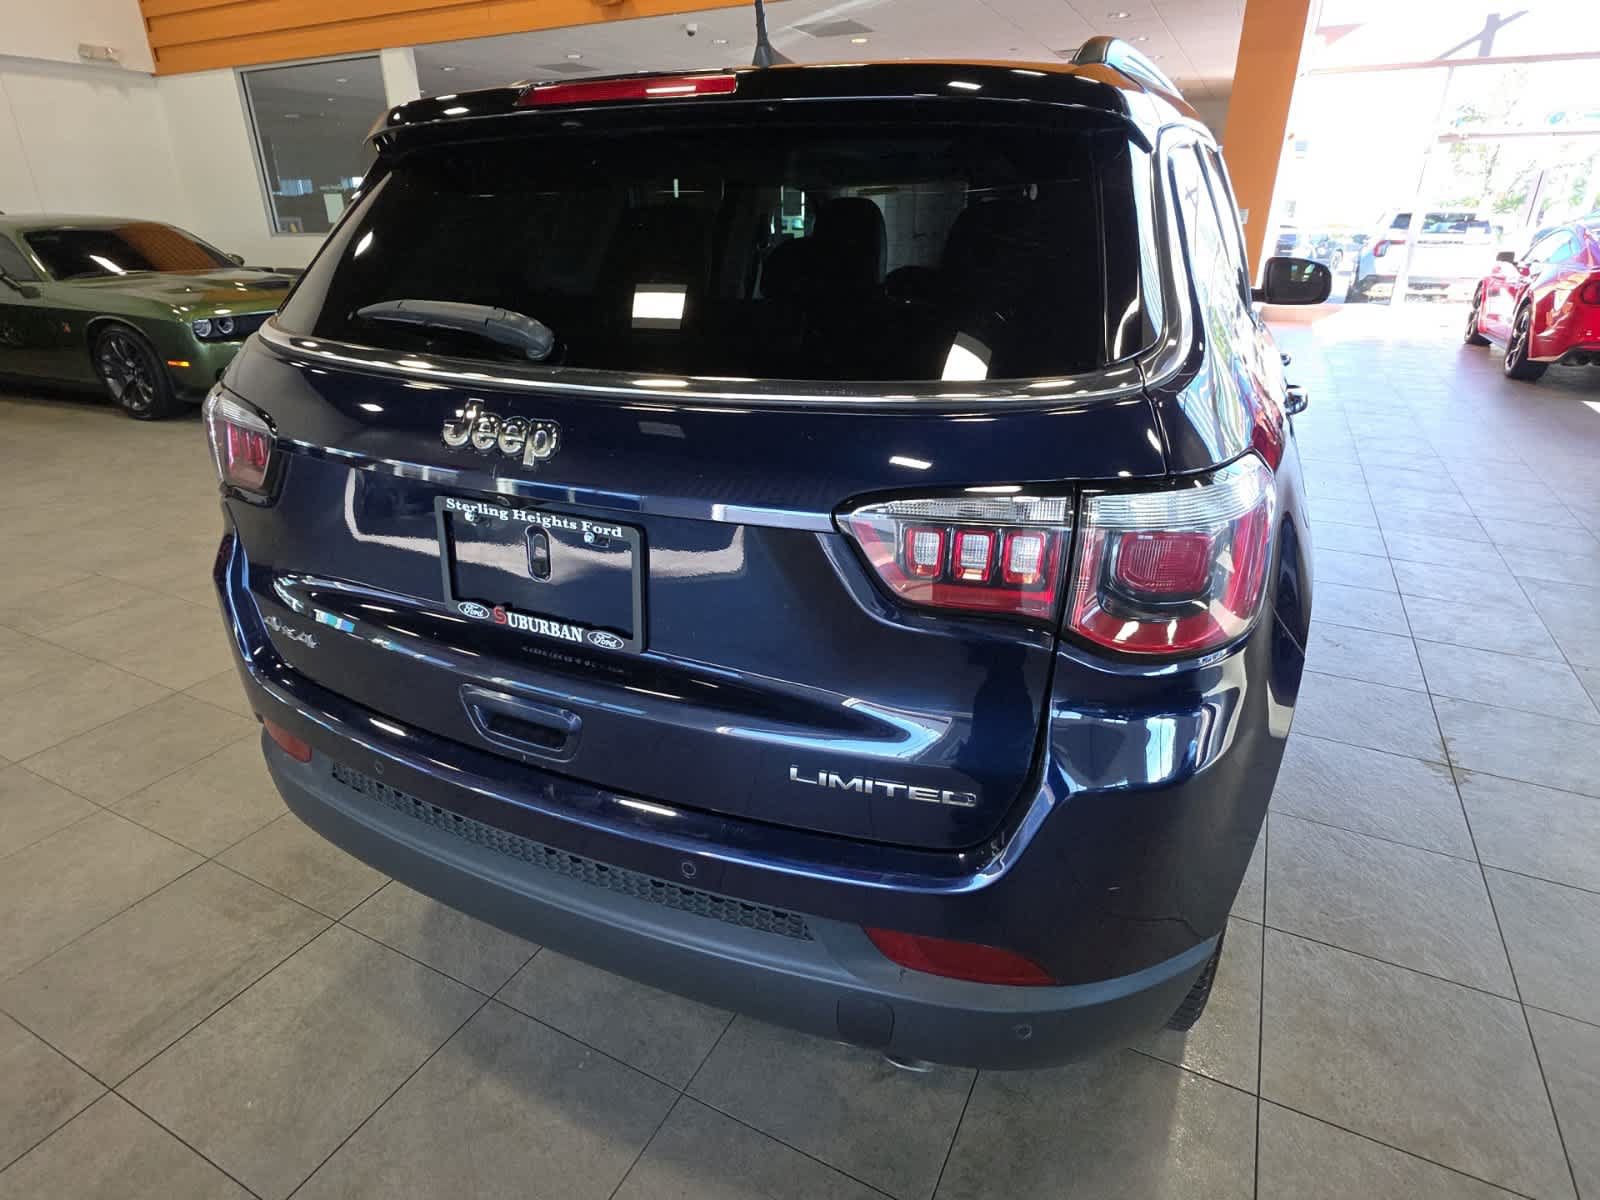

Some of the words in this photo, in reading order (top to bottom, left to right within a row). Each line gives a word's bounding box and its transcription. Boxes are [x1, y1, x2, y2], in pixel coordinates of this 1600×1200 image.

[442, 398, 560, 467] Jeep
[446, 497, 509, 521] Sterling
[511, 509, 577, 529] Heights
[581, 520, 623, 538] Ford
[462, 602, 485, 618] Ford
[493, 606, 584, 643] SUBURBAN
[593, 631, 618, 648] Ford
[789, 764, 977, 808] LIMITED
